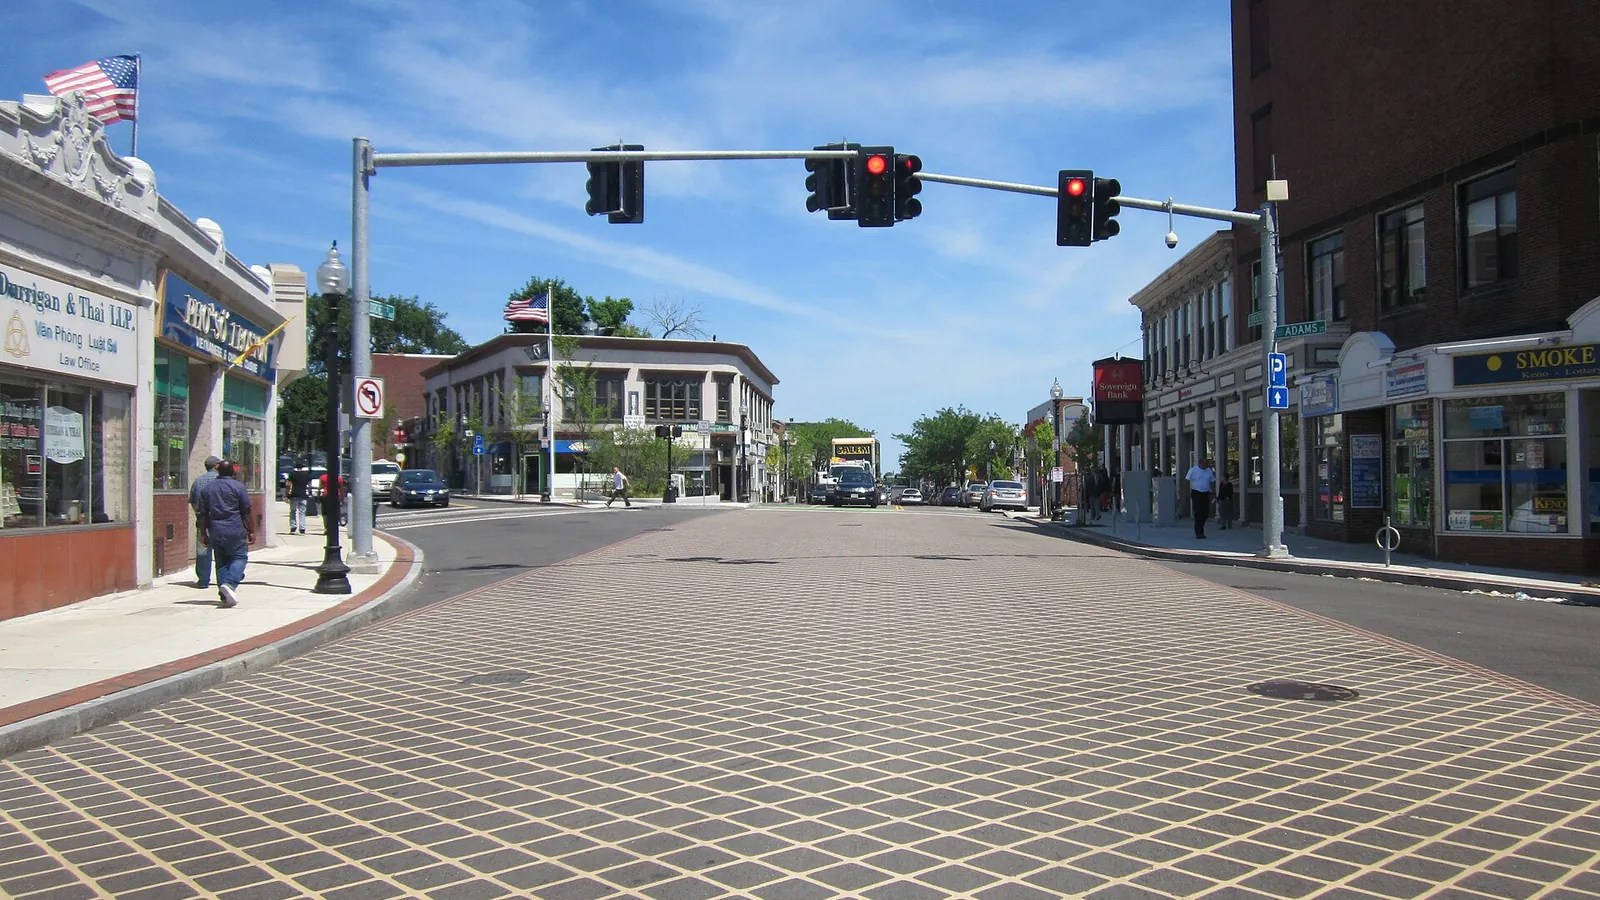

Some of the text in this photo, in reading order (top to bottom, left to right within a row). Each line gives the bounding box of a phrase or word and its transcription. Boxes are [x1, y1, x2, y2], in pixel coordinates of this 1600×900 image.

[66, 292, 76, 316] &
[78, 295, 105, 323] Thai
[1285, 322, 1318, 336] ADAMS
[59, 352, 100, 372] Law Office
[1516, 346, 1596, 369] SMOKE
[1099, 381, 1137, 392] Sovereign
[1107, 391, 1128, 399] Bank
[837, 445, 871, 455] SALEM
[1534, 496, 1566, 509] KENO
